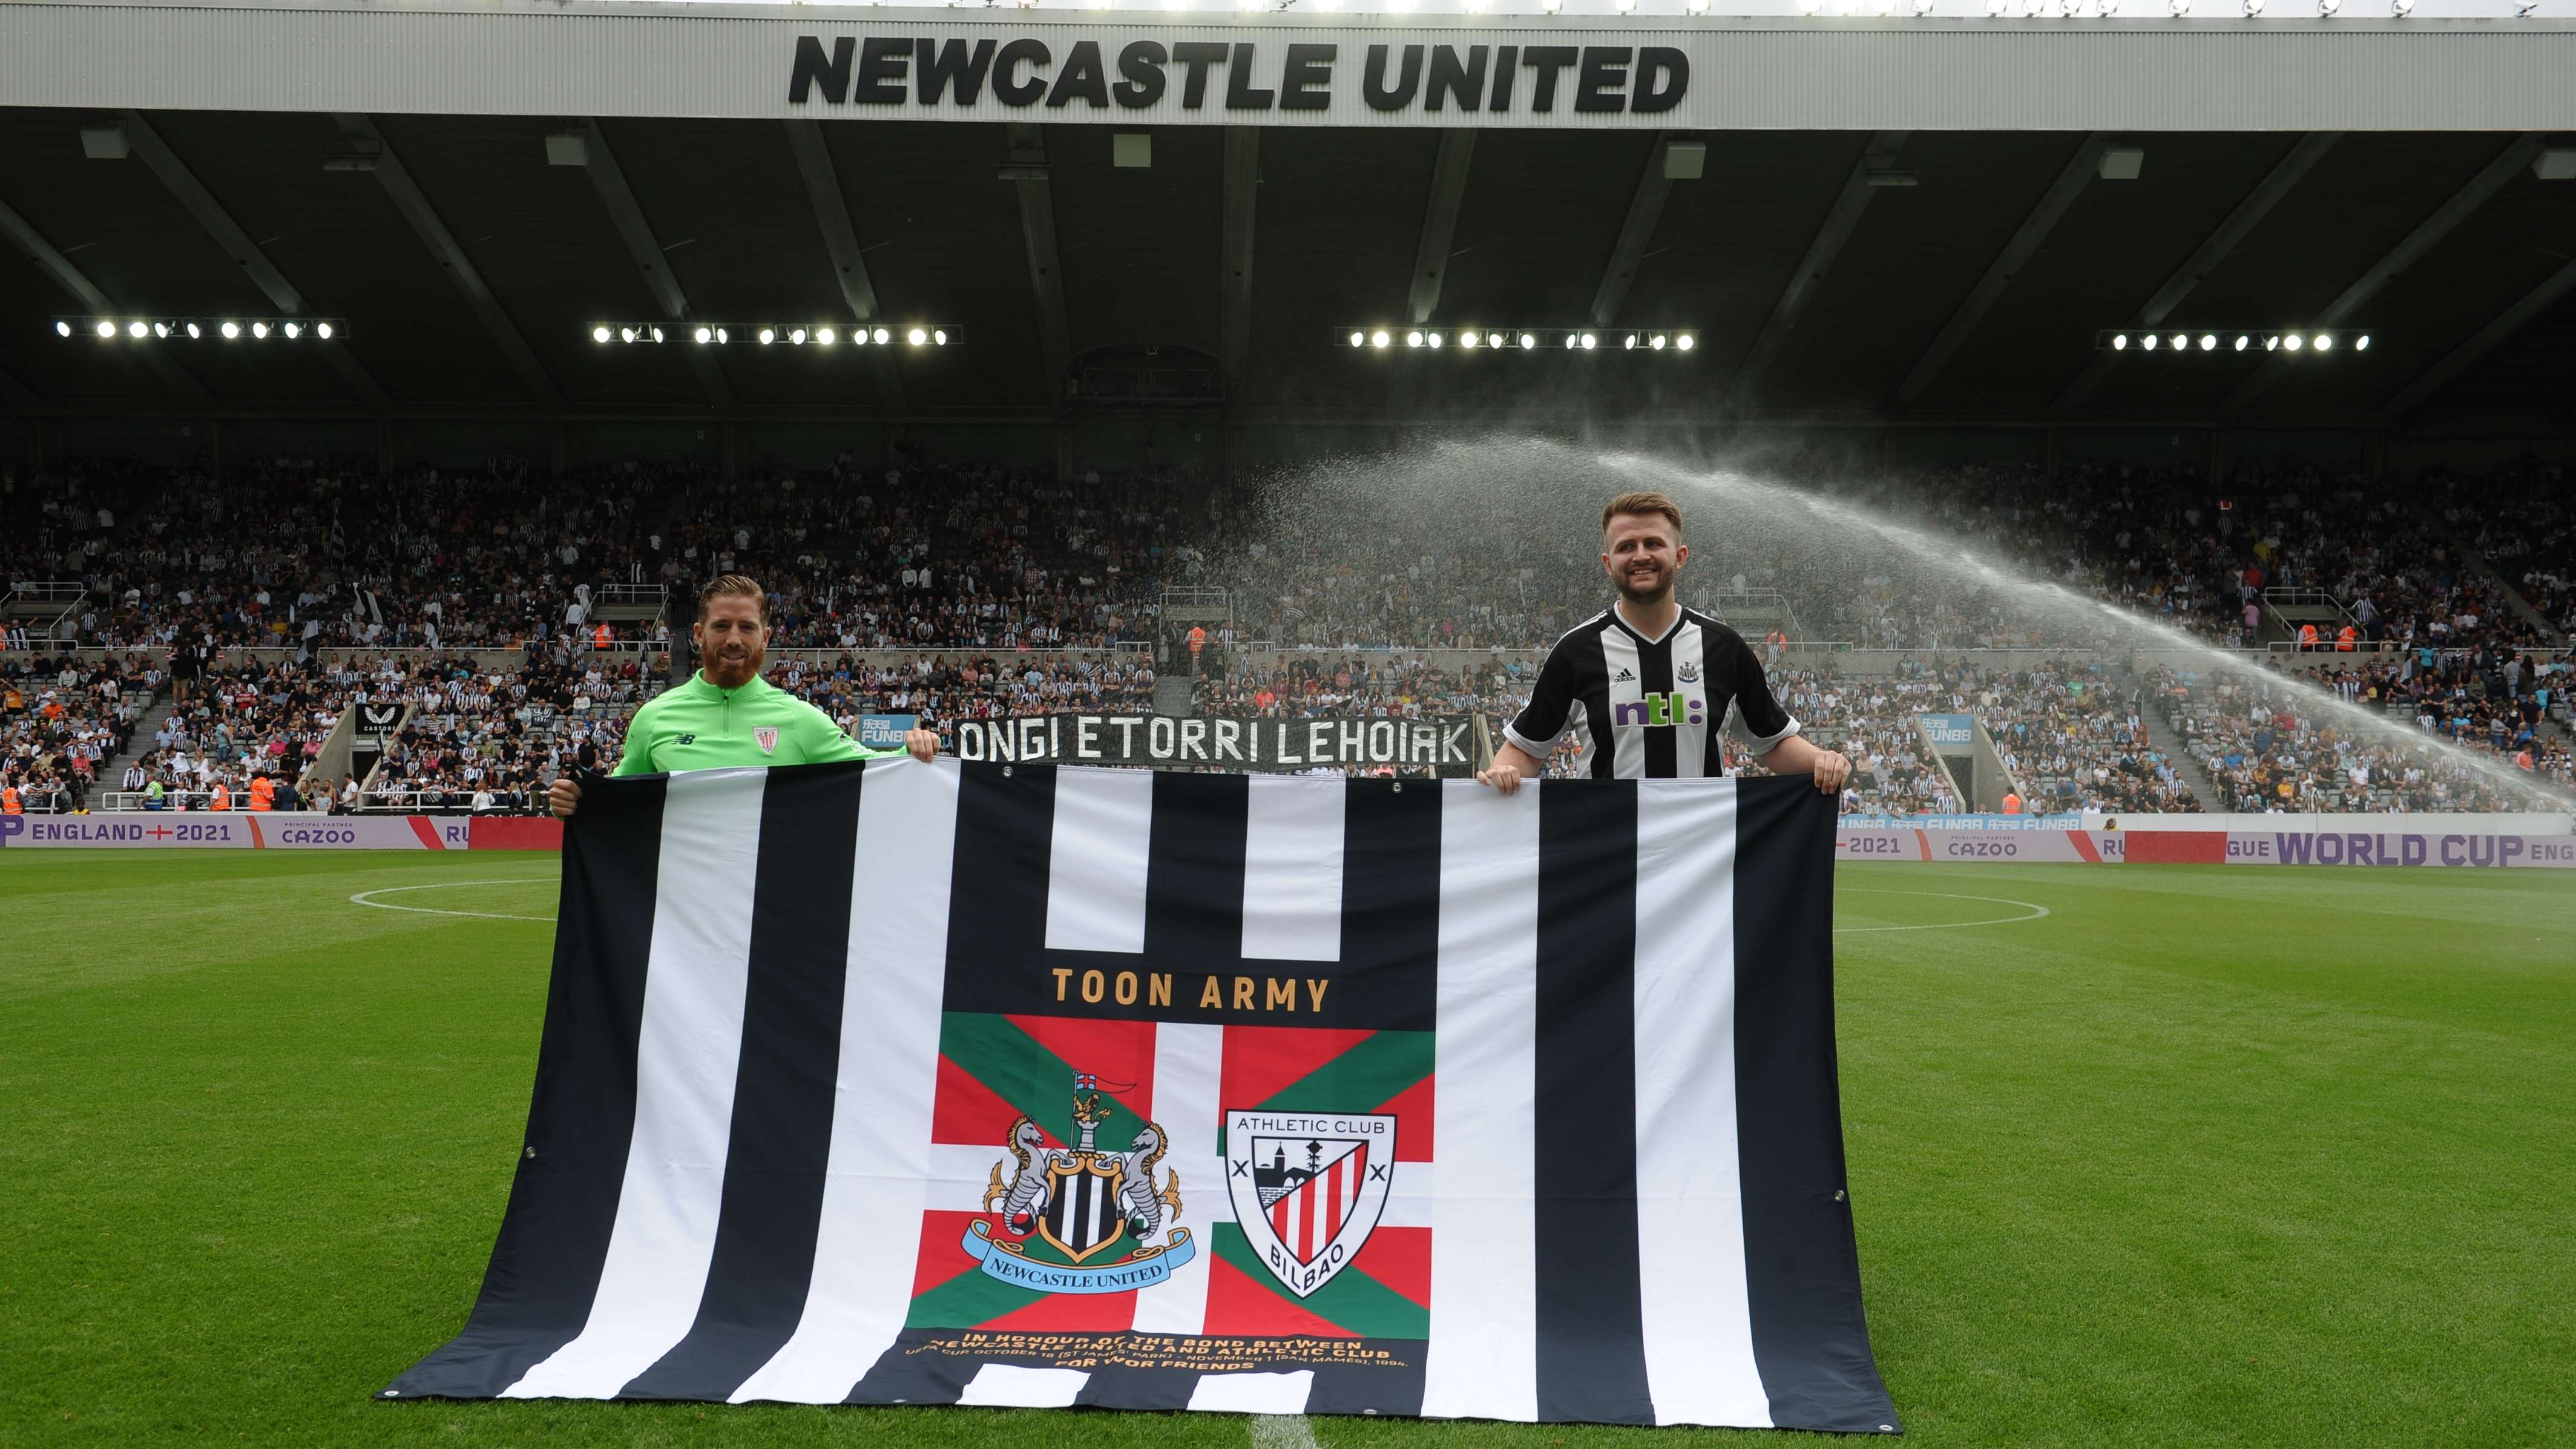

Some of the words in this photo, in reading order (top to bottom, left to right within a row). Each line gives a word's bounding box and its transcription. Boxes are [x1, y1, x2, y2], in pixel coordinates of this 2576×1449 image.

[788, 35, 1338, 110] NEWCASTLE
[1362, 44, 1690, 113] UNITED
[861, 730, 906, 743] FUN8
[959, 717, 1059, 761] ONGI
[1078, 715, 1258, 761] ETORRI
[1278, 720, 1468, 763] LEHOIAK
[32, 824, 142, 840] ENGLAND
[176, 824, 231, 841] 2021
[282, 830, 355, 843] CAZOO
[1850, 837, 1901, 853] 2021
[1948, 843, 2017, 856] CAZOO
[2276, 832, 2426, 866] WORLD
[2441, 835, 2523, 867] CUP
[1052, 968, 1172, 1006] TOON
[1199, 976, 1329, 1012] ARMY
[1237, 1118, 1327, 1132] ATHLETIC
[1335, 1120, 1385, 1134] CLUB
[989, 1258, 1092, 1287] NEWCASTLE
[1097, 1264, 1162, 1287] UNITED
[1270, 1243, 1344, 1292] BILBAO
[930, 1340, 1066, 1350] NEWCASTLE
[1074, 1342, 1155, 1351] UNITED
[1163, 1346, 1209, 1354] AND
[1217, 1347, 1324, 1356] ATHLETIC
[1333, 1350, 1390, 1358] CLUB
[994, 1334, 1089, 1344] HONOUR
[1097, 1336, 1126, 1345] OF
[1133, 1336, 1175, 1346] THE
[1183, 1339, 1245, 1347] BOND
[1254, 1339, 1361, 1349] BETWEEN
[905, 1345, 938, 1355] UEFA
[1054, 1358, 1097, 1367] FOR
[1103, 1356, 1155, 1367] WOR
[1161, 1361, 1255, 1370] FRIENDS
